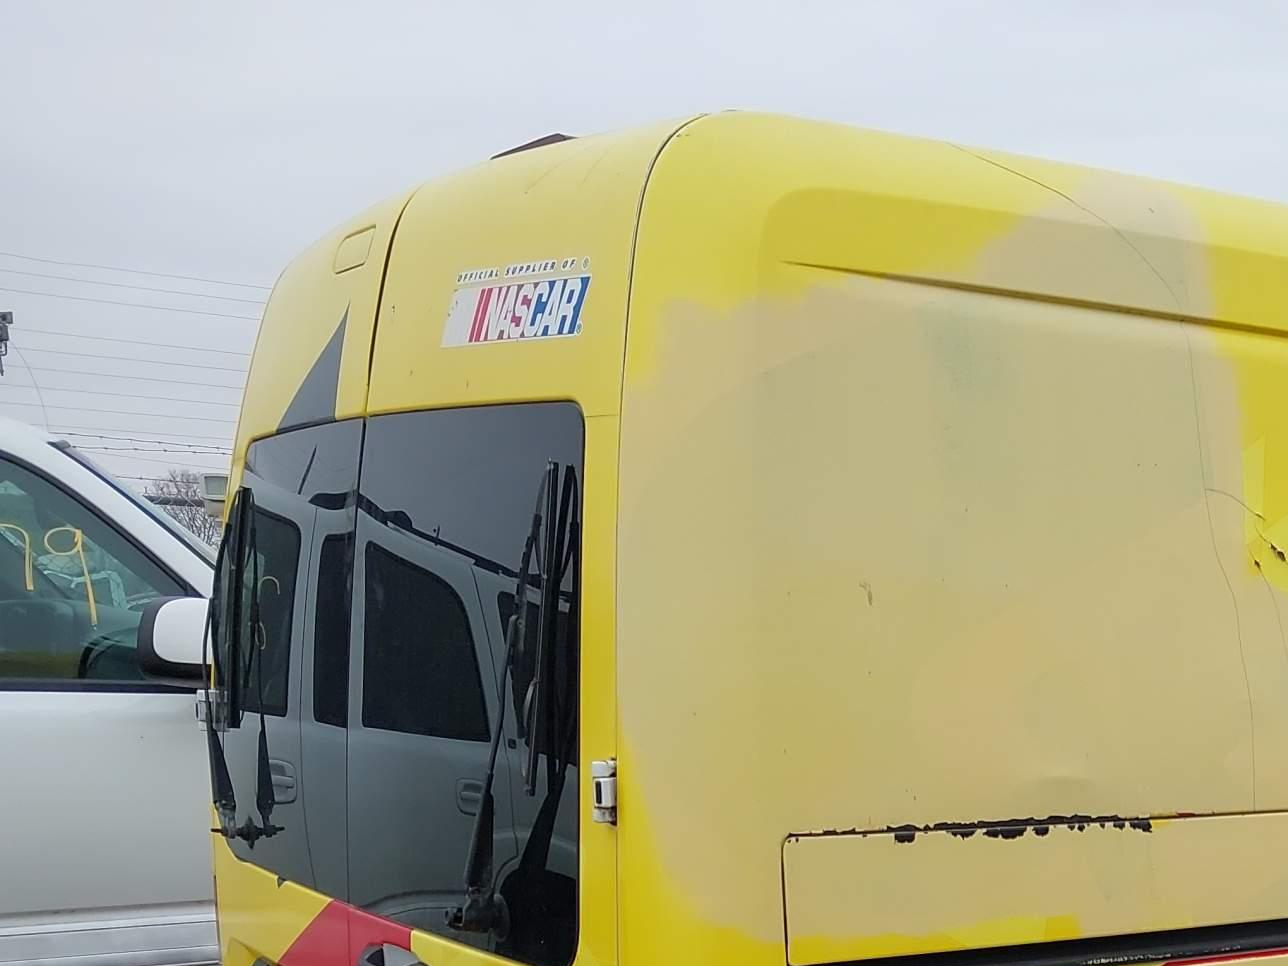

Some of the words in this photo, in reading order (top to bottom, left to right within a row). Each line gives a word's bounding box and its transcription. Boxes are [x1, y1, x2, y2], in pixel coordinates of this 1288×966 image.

[457, 269, 499, 283] OFFICIAL
[505, 259, 556, 276] SUPPLIER
[562, 258, 577, 270] OF
[484, 277, 583, 341] NASCAR
